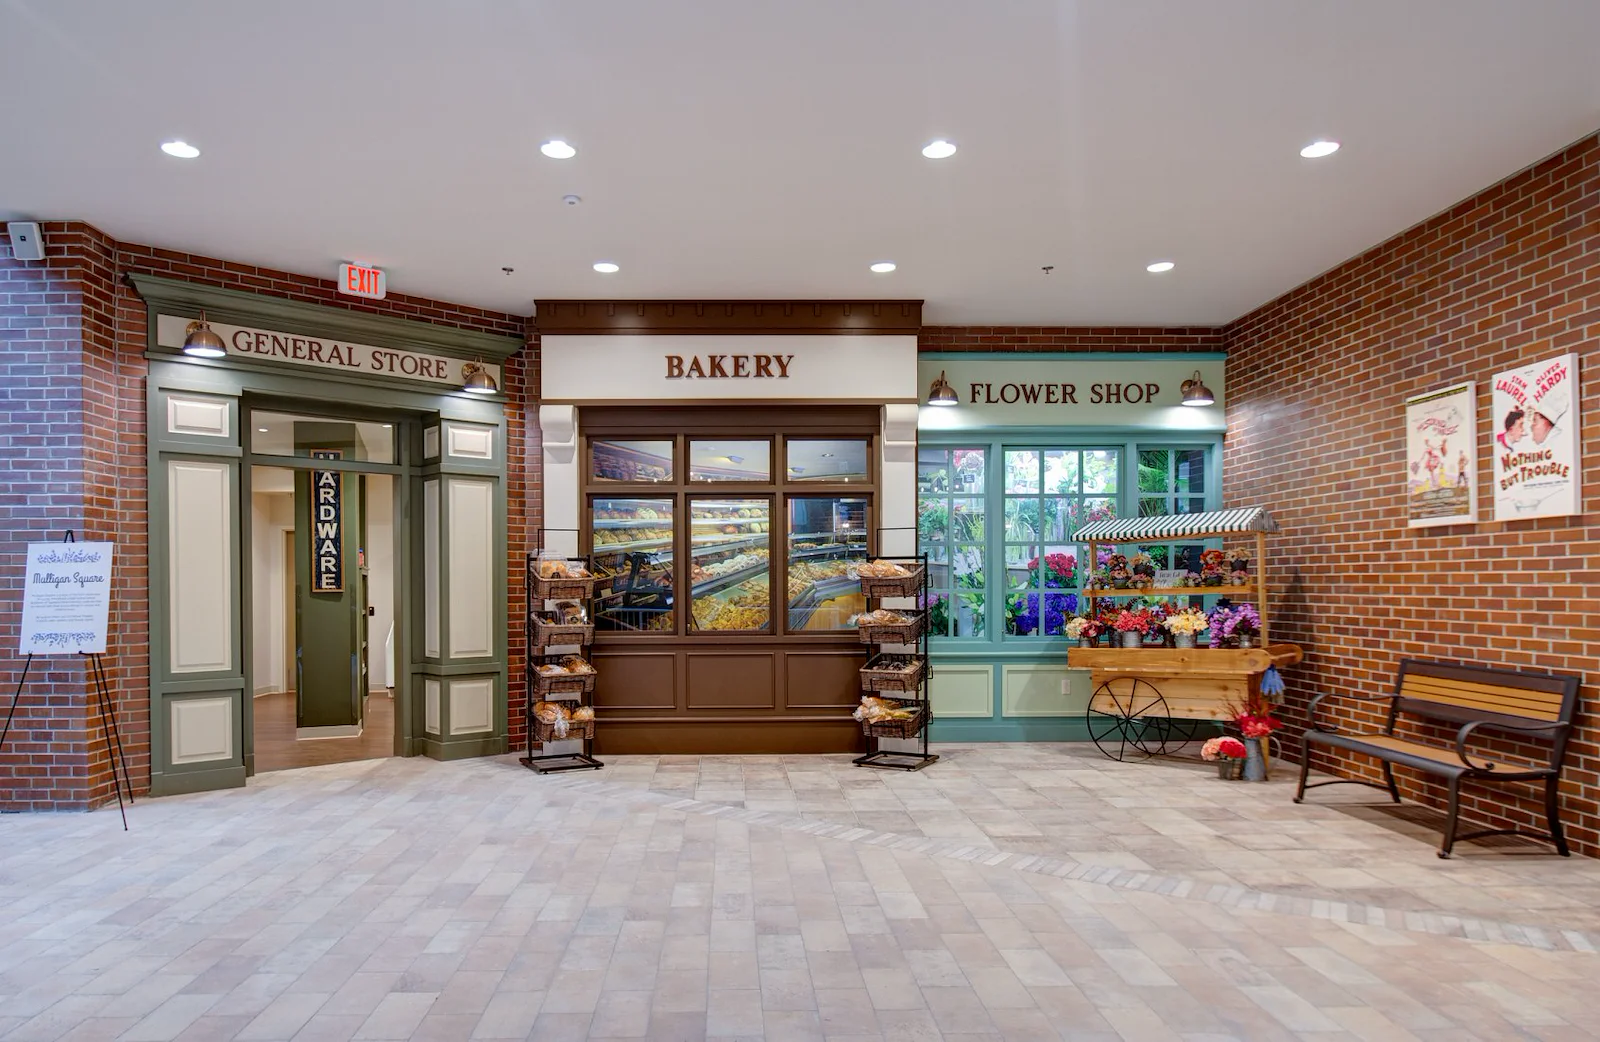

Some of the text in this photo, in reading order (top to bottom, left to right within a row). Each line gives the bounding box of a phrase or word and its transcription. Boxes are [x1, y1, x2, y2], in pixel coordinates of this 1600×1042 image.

[348, 265, 381, 294] EXIT
[232, 330, 448, 379] GENERAL STORE
[665, 354, 794, 379] BAKERY
[1533, 367, 1568, 402] HARDY
[1536, 362, 1561, 386] OLIVER
[970, 383, 1160, 404] FLOWER SHOP
[1495, 379, 1528, 407] LAUREL
[1500, 473, 1519, 491] BUT
[1520, 462, 1570, 483] TROUBLE
[33, 571, 105, 588] Mulligan Square
